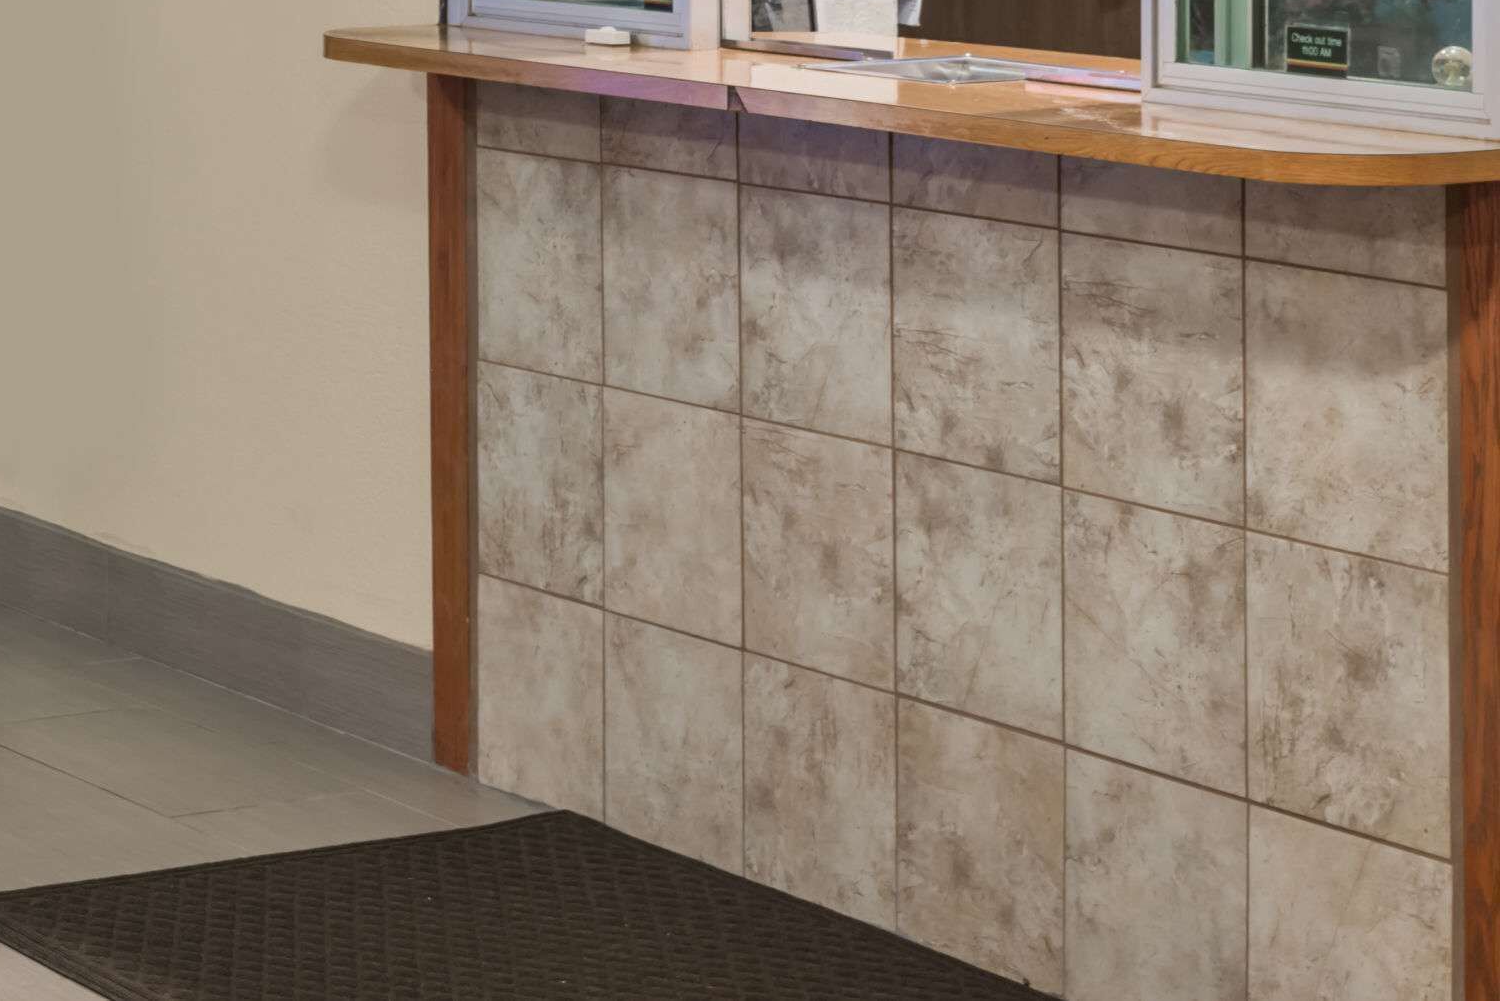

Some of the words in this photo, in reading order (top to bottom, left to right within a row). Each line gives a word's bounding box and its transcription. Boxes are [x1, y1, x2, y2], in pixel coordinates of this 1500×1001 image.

[1291, 32, 1312, 43] Check
[1327, 37, 1342, 47] time
[1319, 47, 1332, 58] AM
